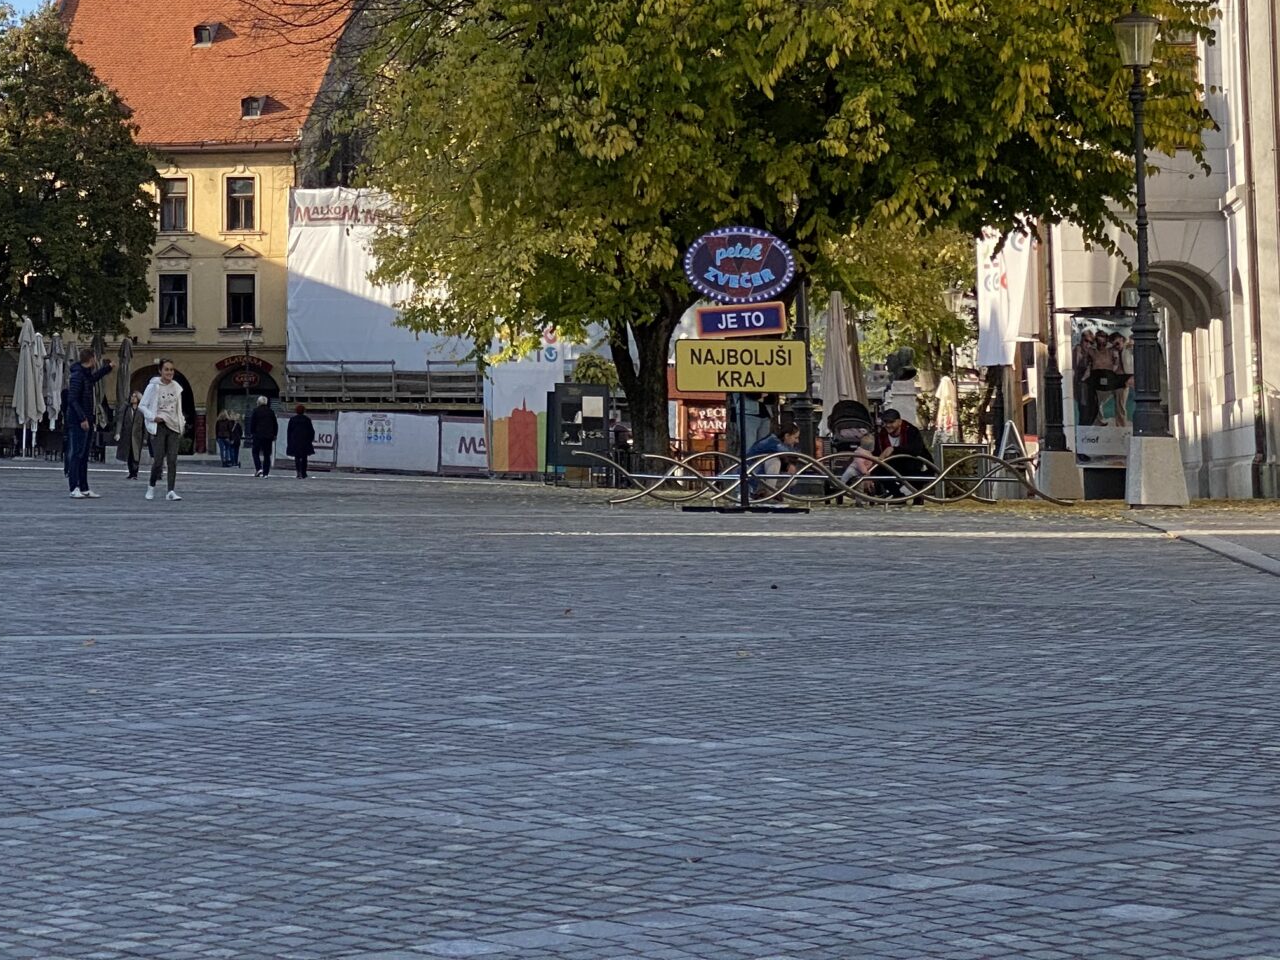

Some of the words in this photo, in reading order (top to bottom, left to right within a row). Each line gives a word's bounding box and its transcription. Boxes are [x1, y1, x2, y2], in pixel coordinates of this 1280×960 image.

[715, 243, 763, 265] petek
[704, 267, 776, 288] ZVEČER
[718, 313, 738, 329] JE
[741, 311, 765, 327] TO
[690, 344, 792, 366] NAJBOLJŠI
[717, 371, 765, 388] KRAJ
